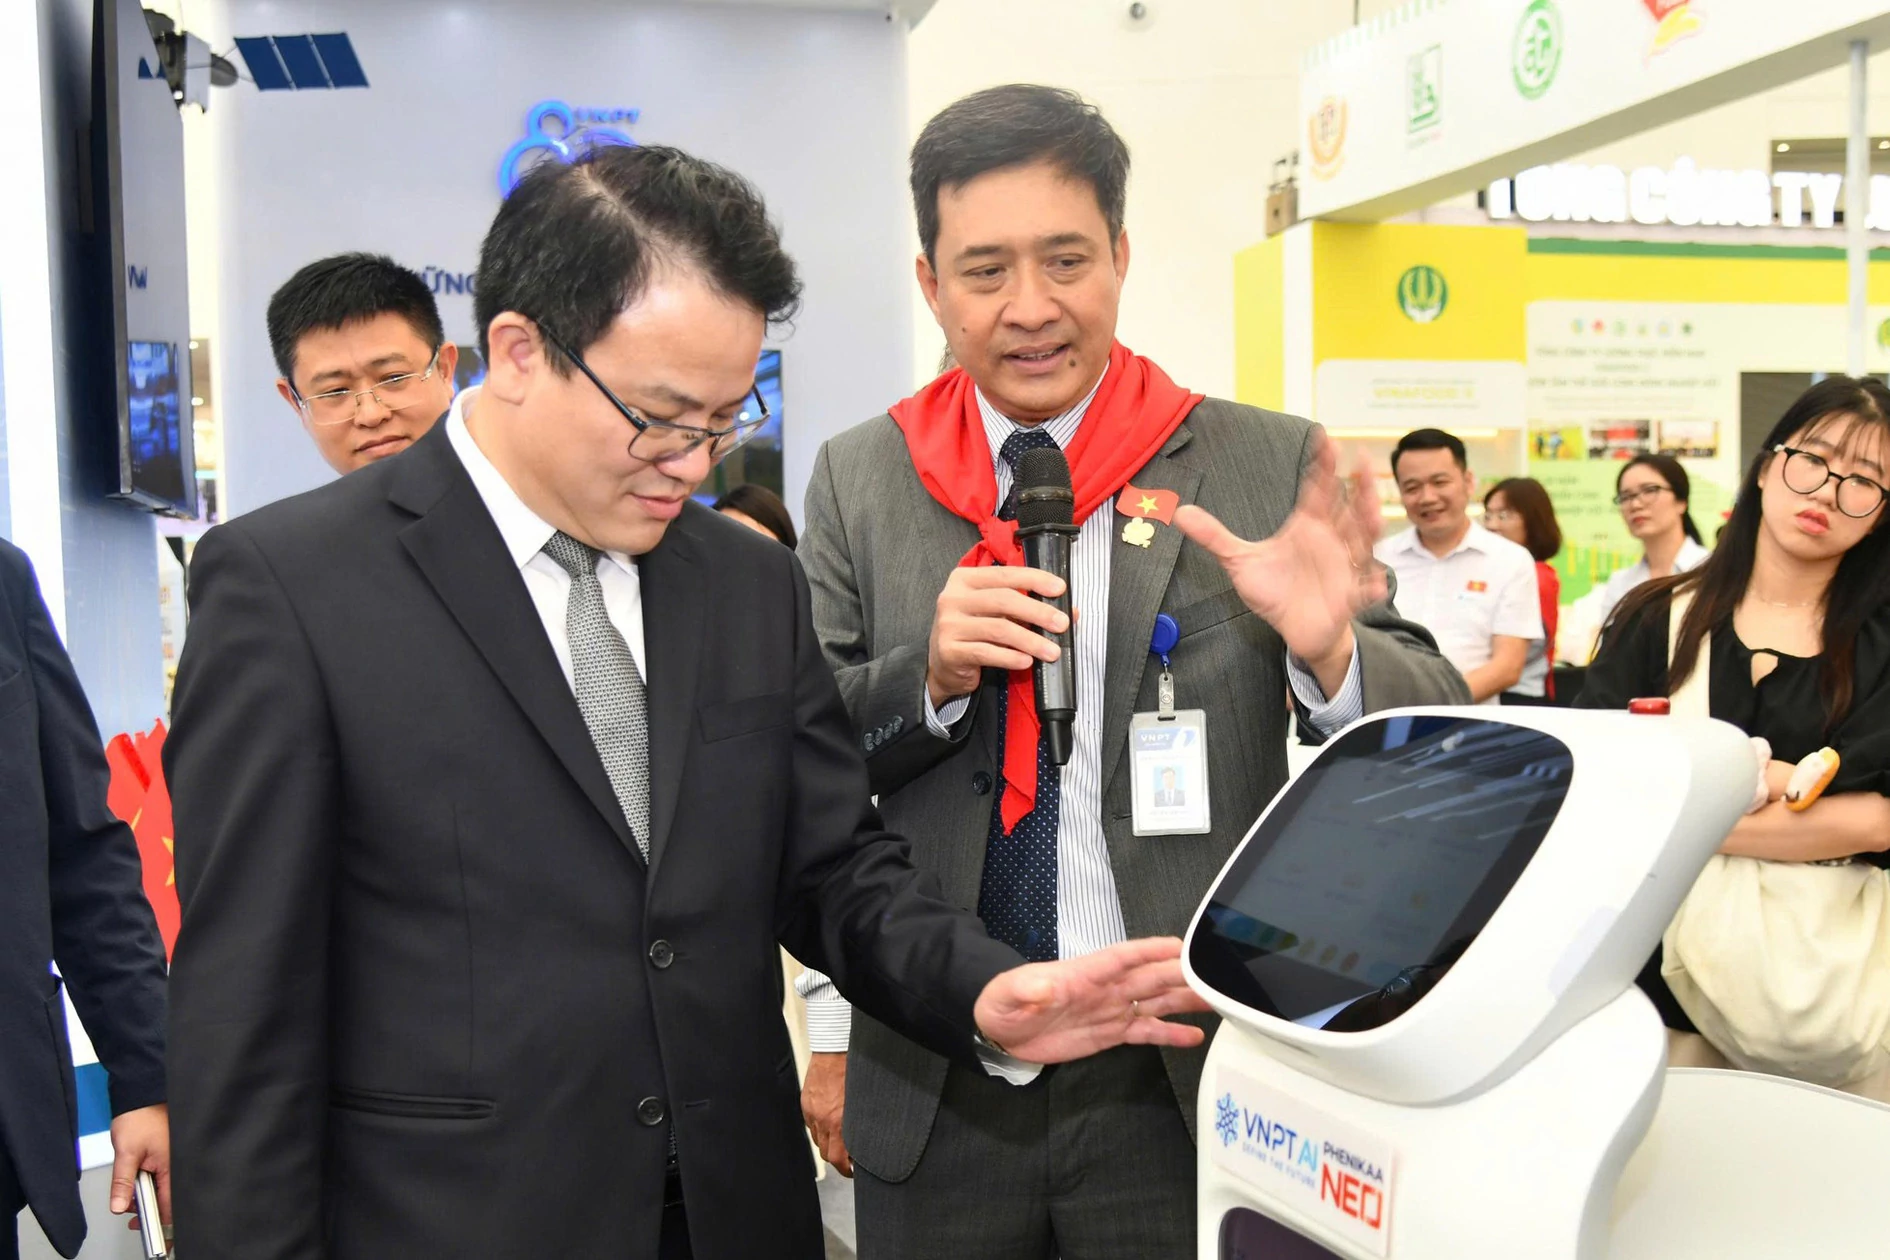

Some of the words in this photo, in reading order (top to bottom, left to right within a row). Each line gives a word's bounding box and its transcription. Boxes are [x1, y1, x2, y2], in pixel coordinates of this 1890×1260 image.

[1140, 733, 1170, 742] VNPT
[1244, 1107, 1297, 1160] VNPT
[1298, 1138, 1318, 1172] AI
[1323, 1141, 1383, 1183] PHENIKAA
[1321, 1162, 1383, 1229] NEO
